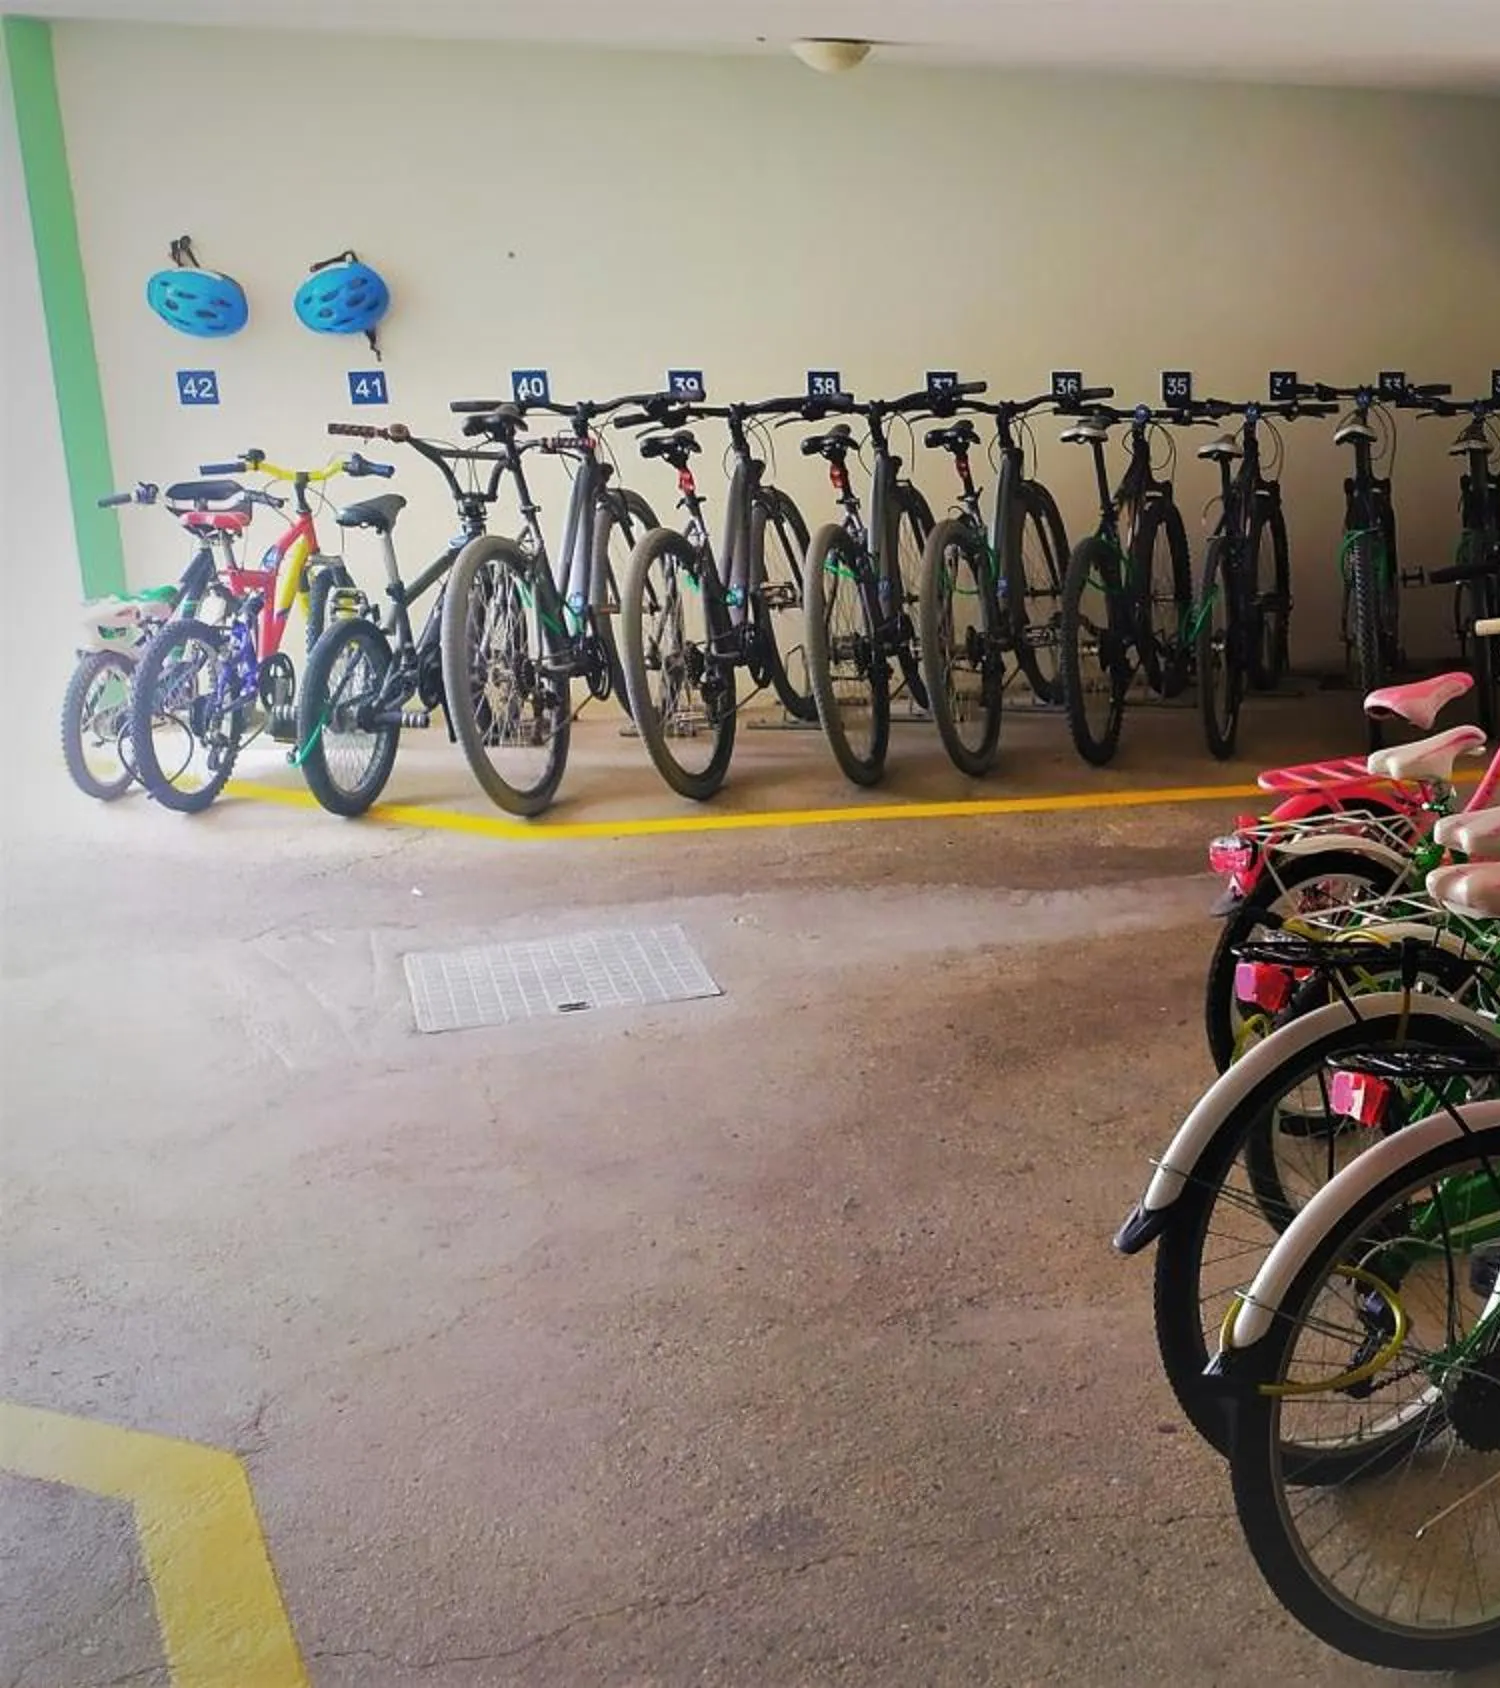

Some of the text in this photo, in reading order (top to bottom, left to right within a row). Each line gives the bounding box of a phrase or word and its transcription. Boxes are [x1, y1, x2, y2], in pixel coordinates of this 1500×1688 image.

[183, 377, 214, 399] 42
[355, 378, 383, 398] 41
[517, 376, 545, 399] 40
[673, 377, 699, 392] 39
[812, 377, 836, 396] 38
[1055, 377, 1079, 396] 36
[1166, 377, 1188, 396] 35
